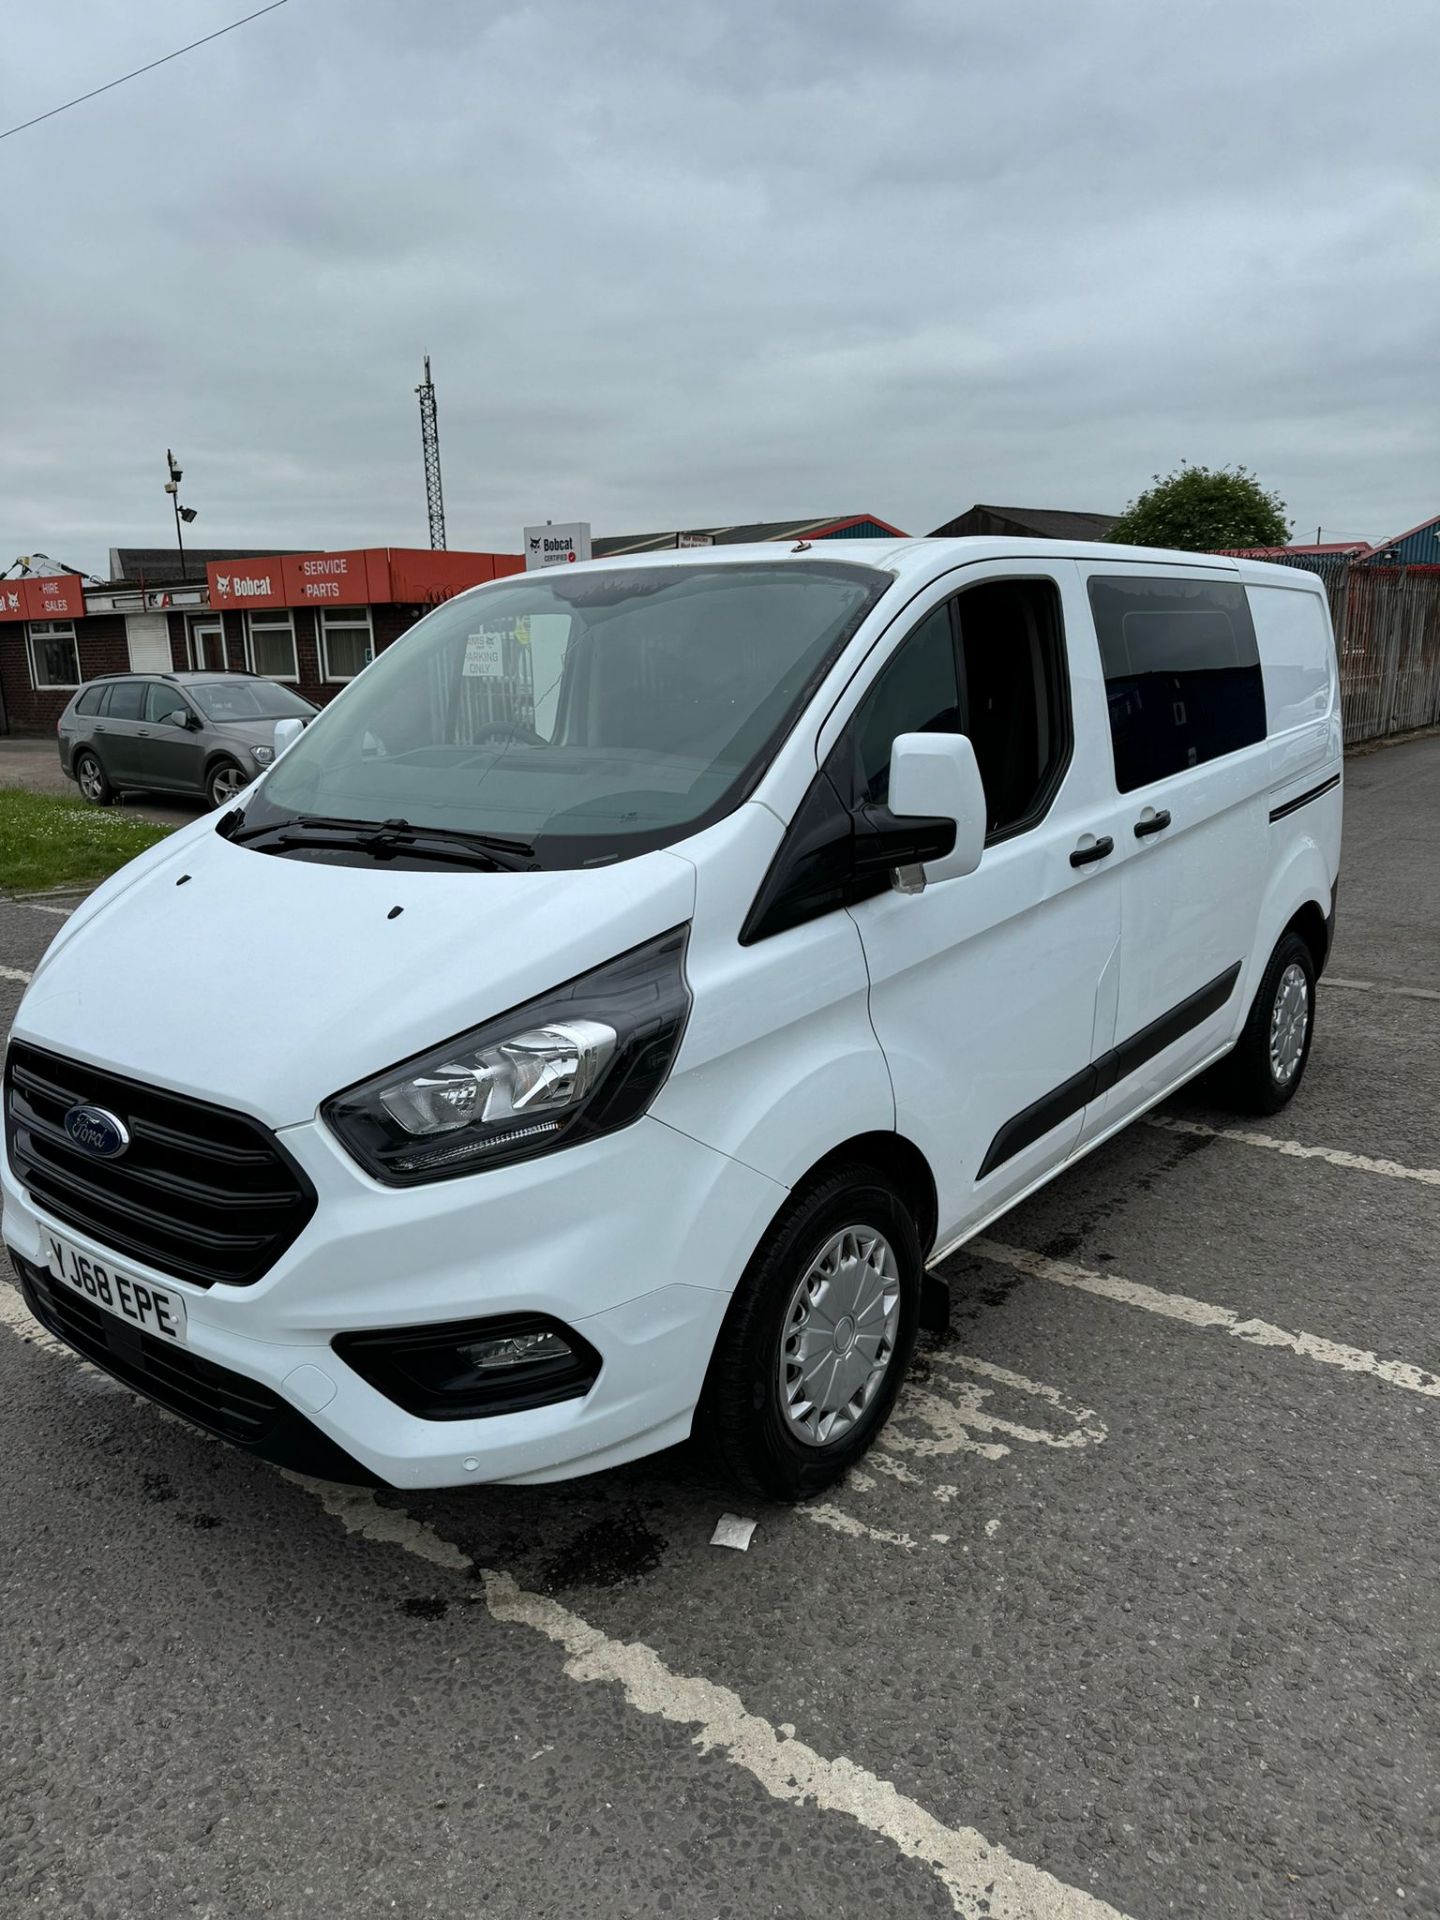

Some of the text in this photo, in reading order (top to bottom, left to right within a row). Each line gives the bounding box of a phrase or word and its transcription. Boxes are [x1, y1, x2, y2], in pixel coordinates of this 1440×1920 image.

[543, 537, 573, 551] Bobcat
[303, 558, 348, 576] SERVICE
[42, 582, 60, 594] HIRE
[232, 575, 272, 597] Bobcat
[305, 582, 340, 598] PARTS
[44, 599, 69, 612] SALES
[469, 663, 490, 674] ONLY
[72, 1112, 108, 1148] Ford
[50, 1237, 177, 1338] YJ68 EPE
